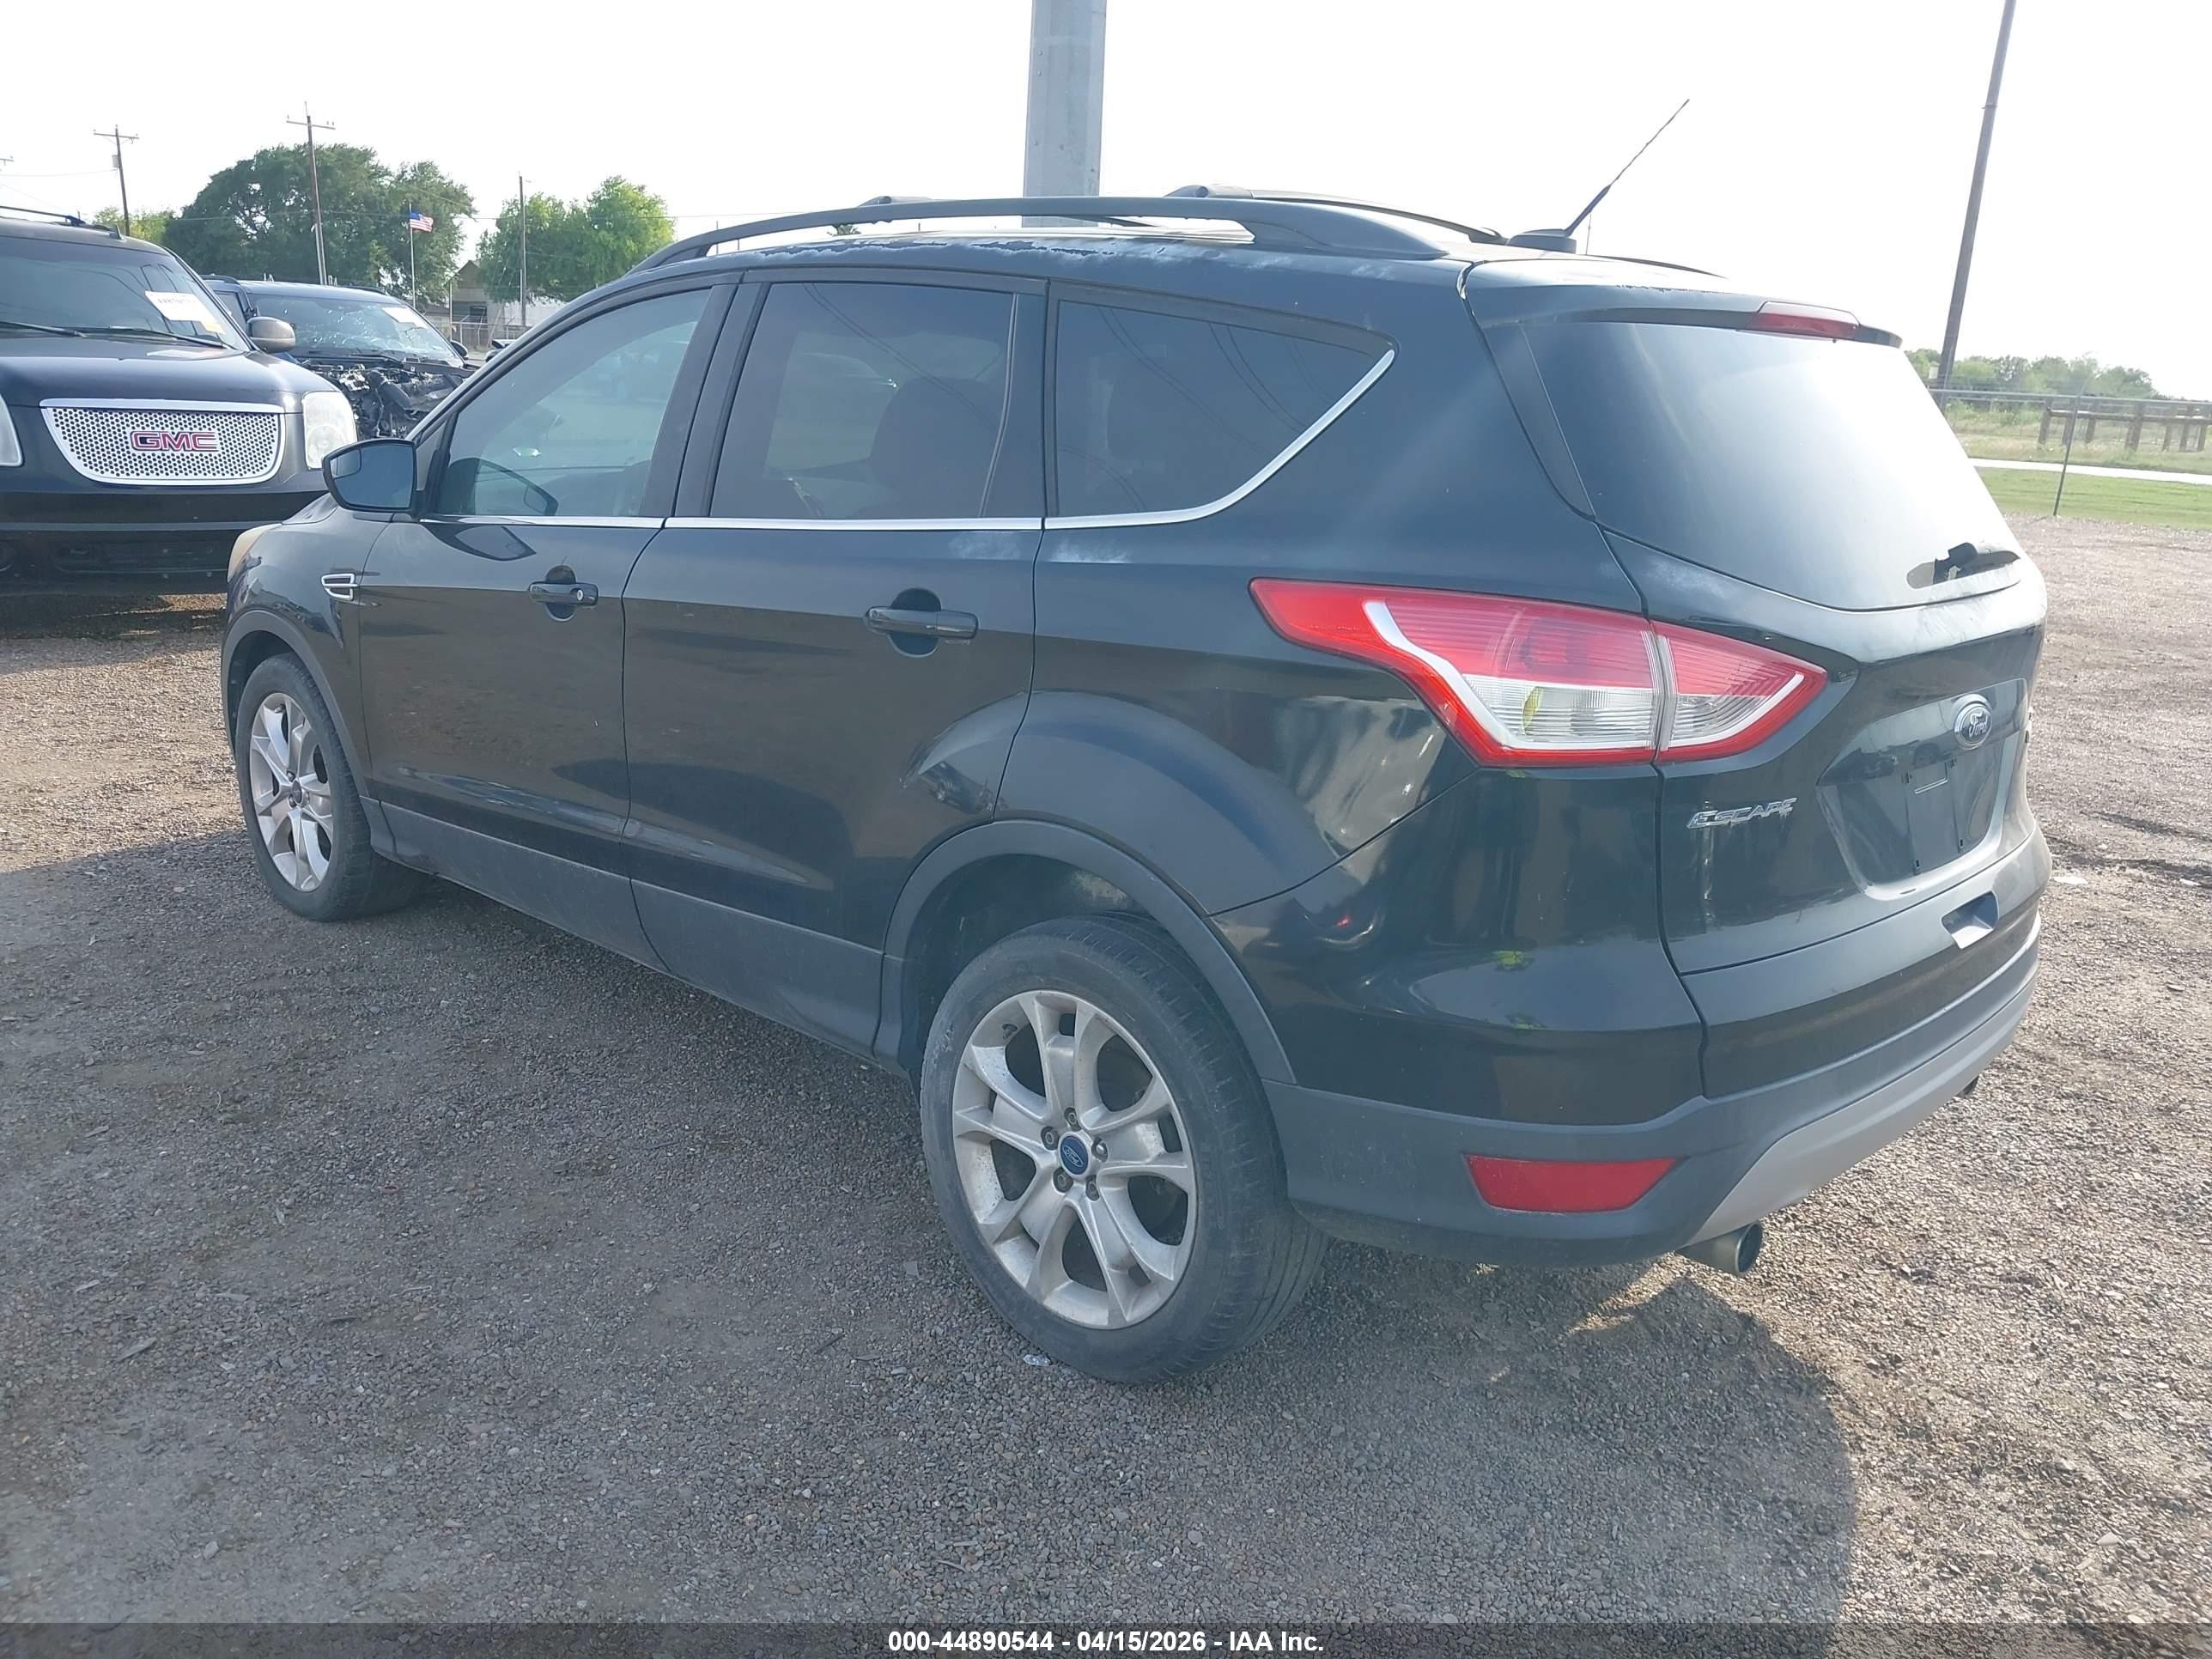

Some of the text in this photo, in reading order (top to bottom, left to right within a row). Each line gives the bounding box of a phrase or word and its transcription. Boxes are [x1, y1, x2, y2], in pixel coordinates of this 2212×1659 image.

[130, 430, 220, 453] GMC
[1968, 710, 1989, 738] Ford
[1686, 797, 1798, 829] ESCAPE
